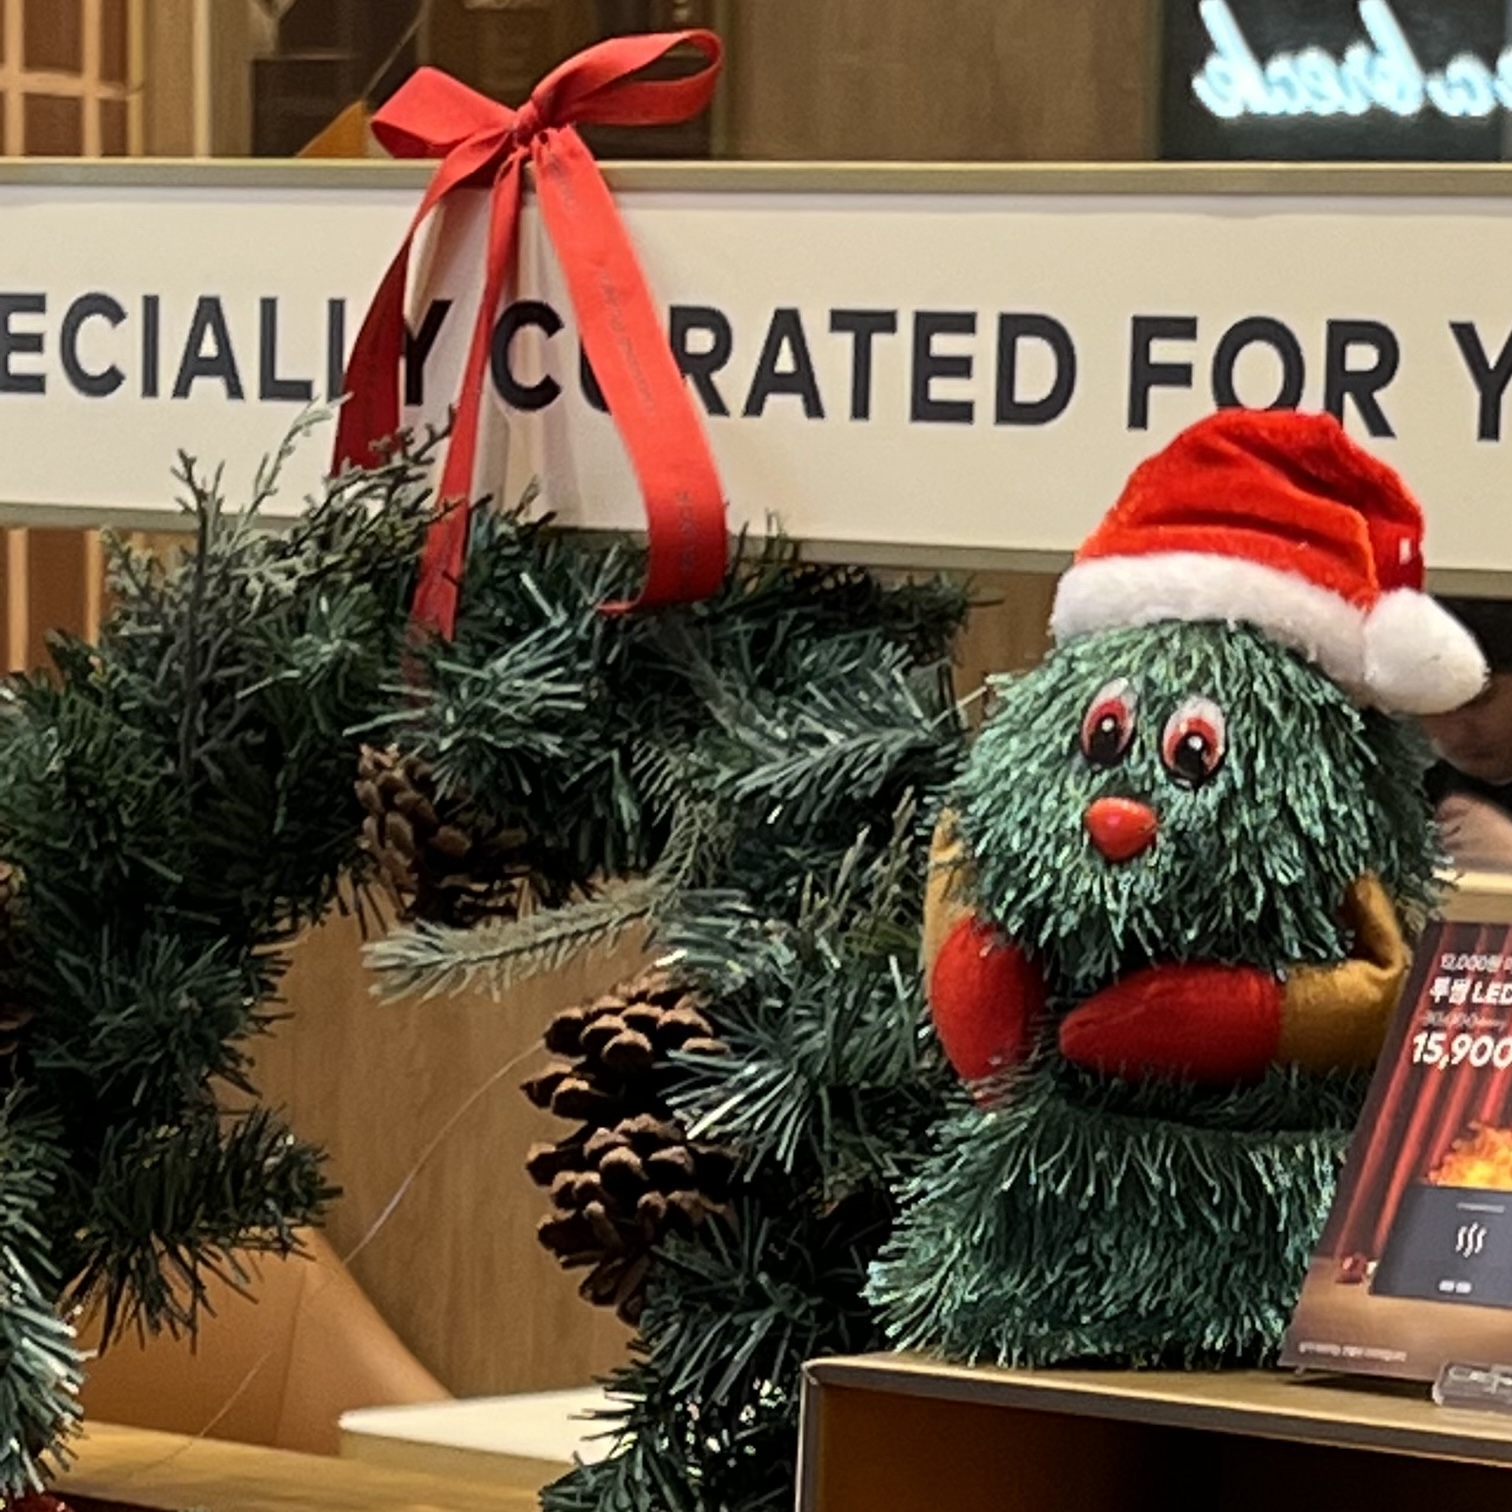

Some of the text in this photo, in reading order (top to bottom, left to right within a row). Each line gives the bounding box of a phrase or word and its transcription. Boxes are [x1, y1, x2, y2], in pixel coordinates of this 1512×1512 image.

[490, 302, 1077, 425] CRATED
[1126, 315, 1401, 439] FOR
[1430, 976, 1471, 1005] 투썸
